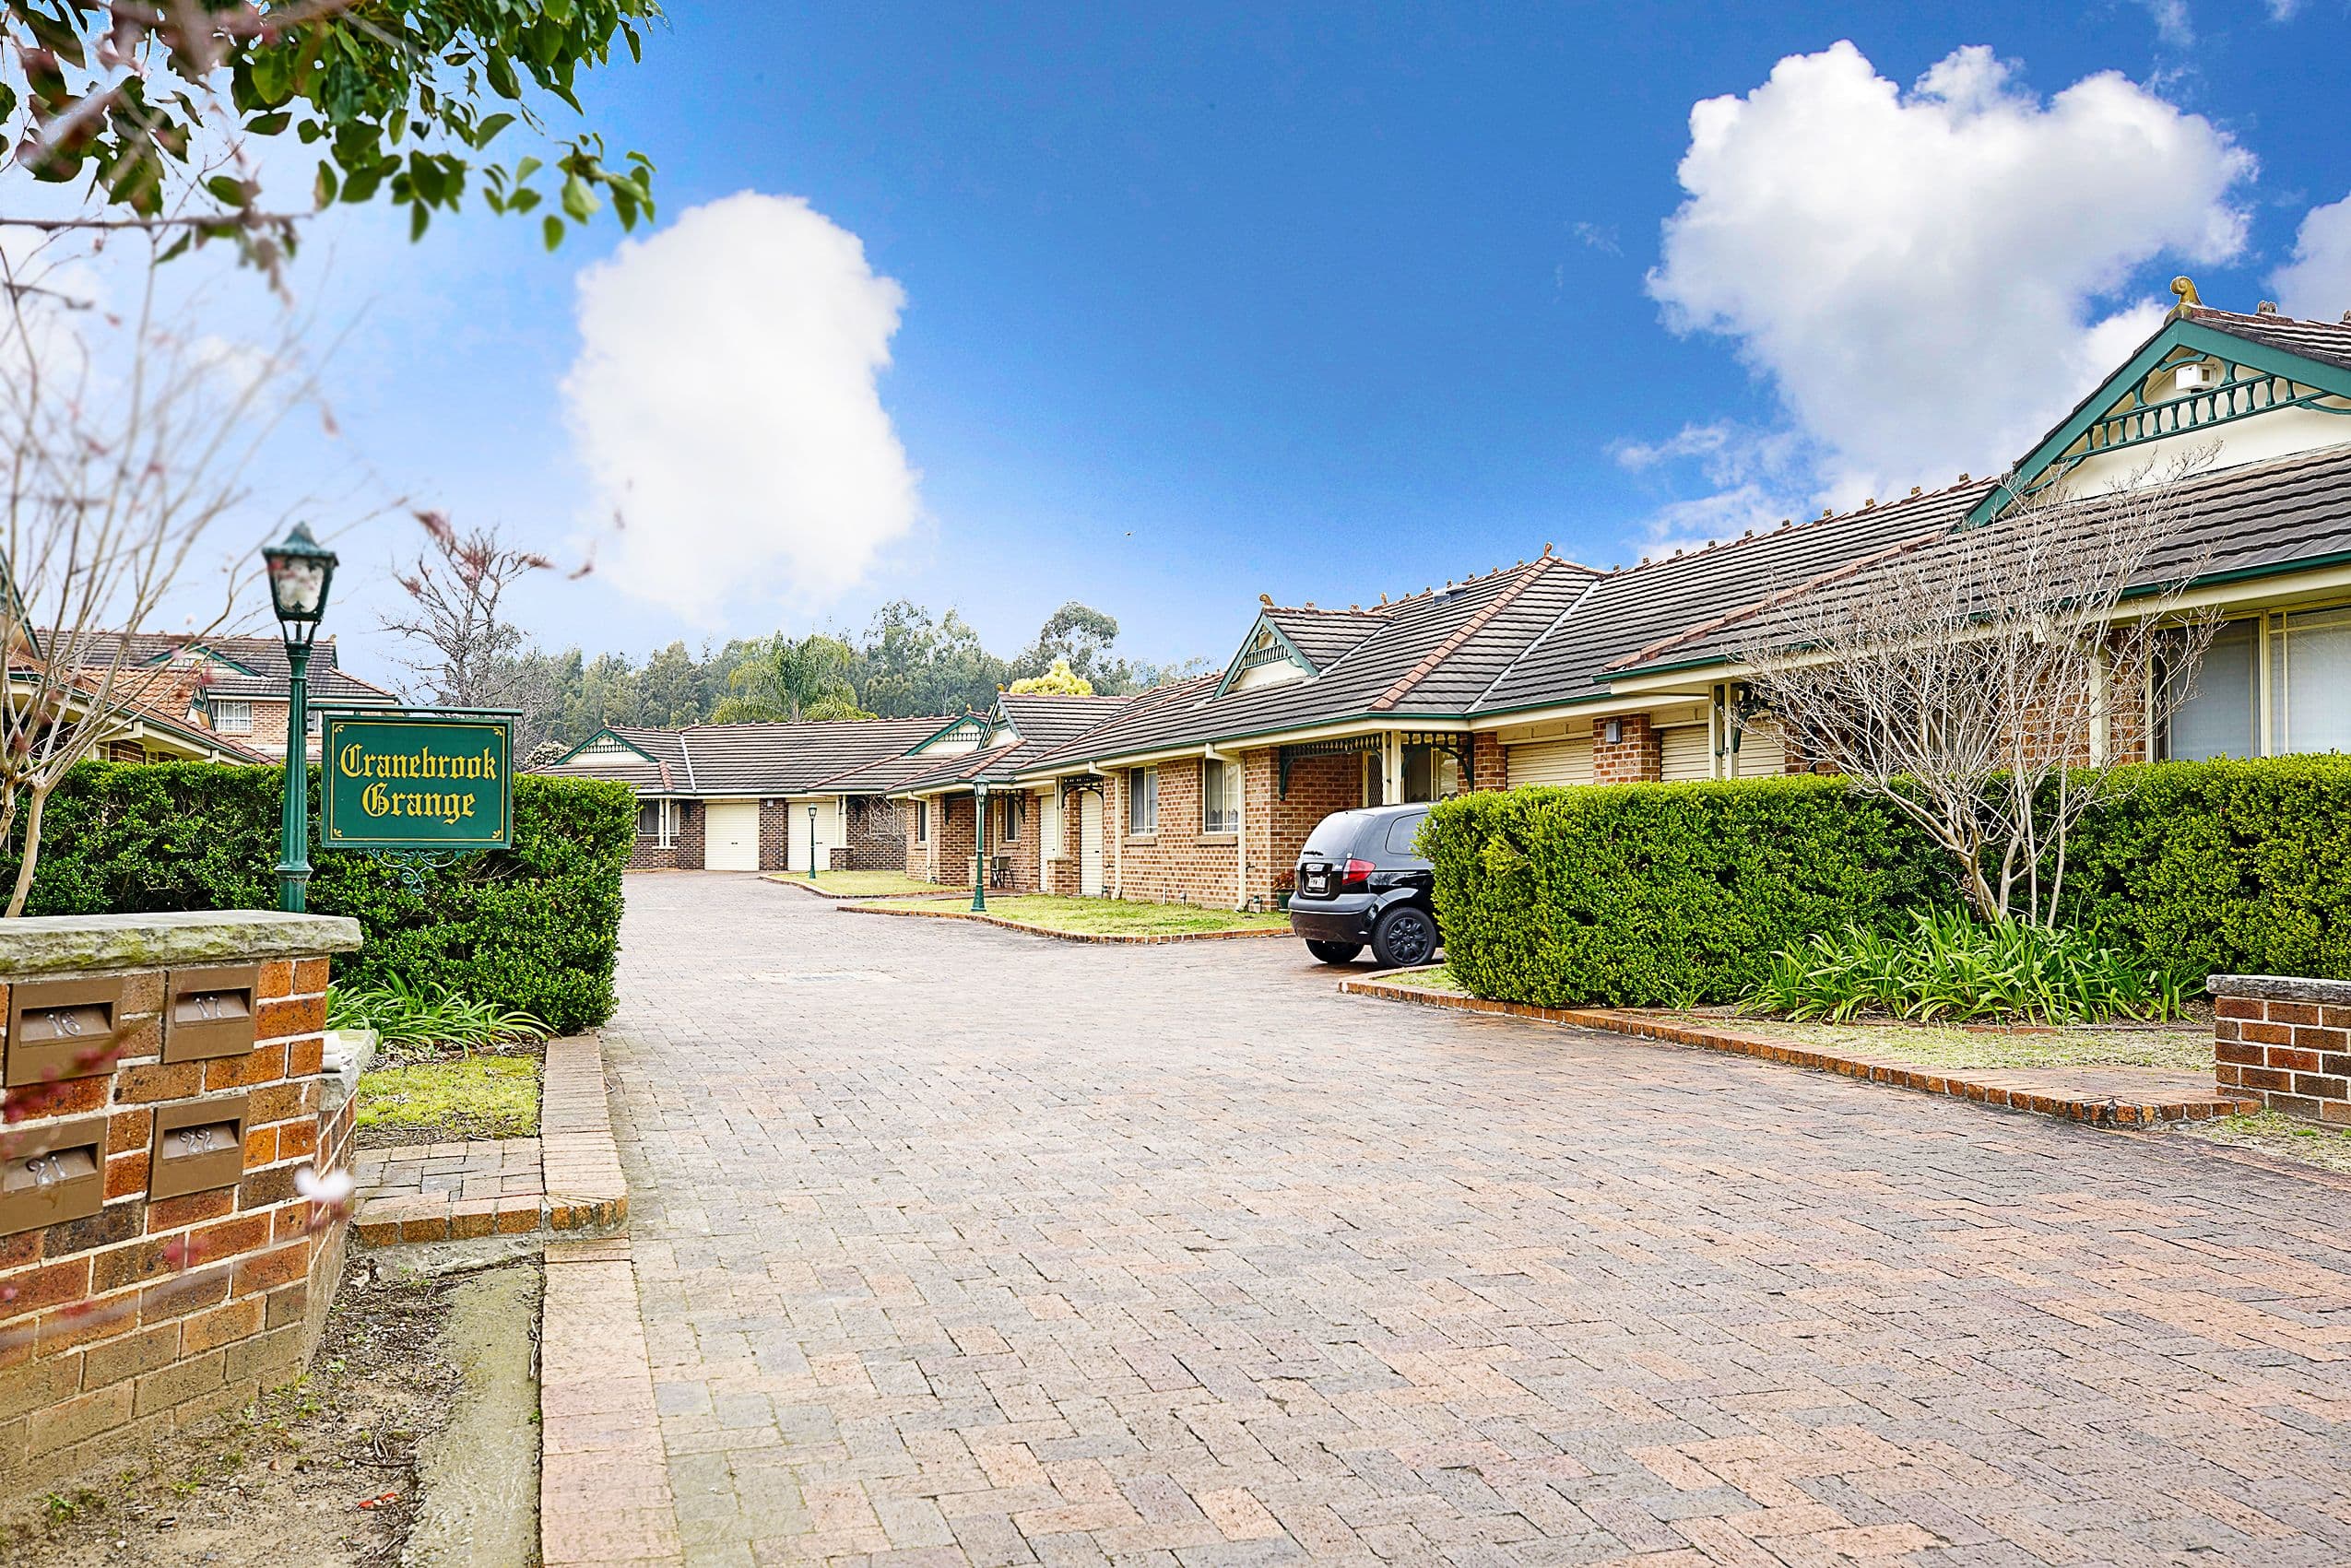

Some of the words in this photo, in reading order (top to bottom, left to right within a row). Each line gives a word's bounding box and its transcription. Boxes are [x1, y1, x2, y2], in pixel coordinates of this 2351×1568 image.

[339, 743, 497, 780] Cranebrook
[361, 782, 476, 825] Grange
[193, 996, 222, 1020] 17
[45, 1011, 81, 1036] 16
[179, 1127, 218, 1154] 22
[26, 1153, 66, 1186] 21
